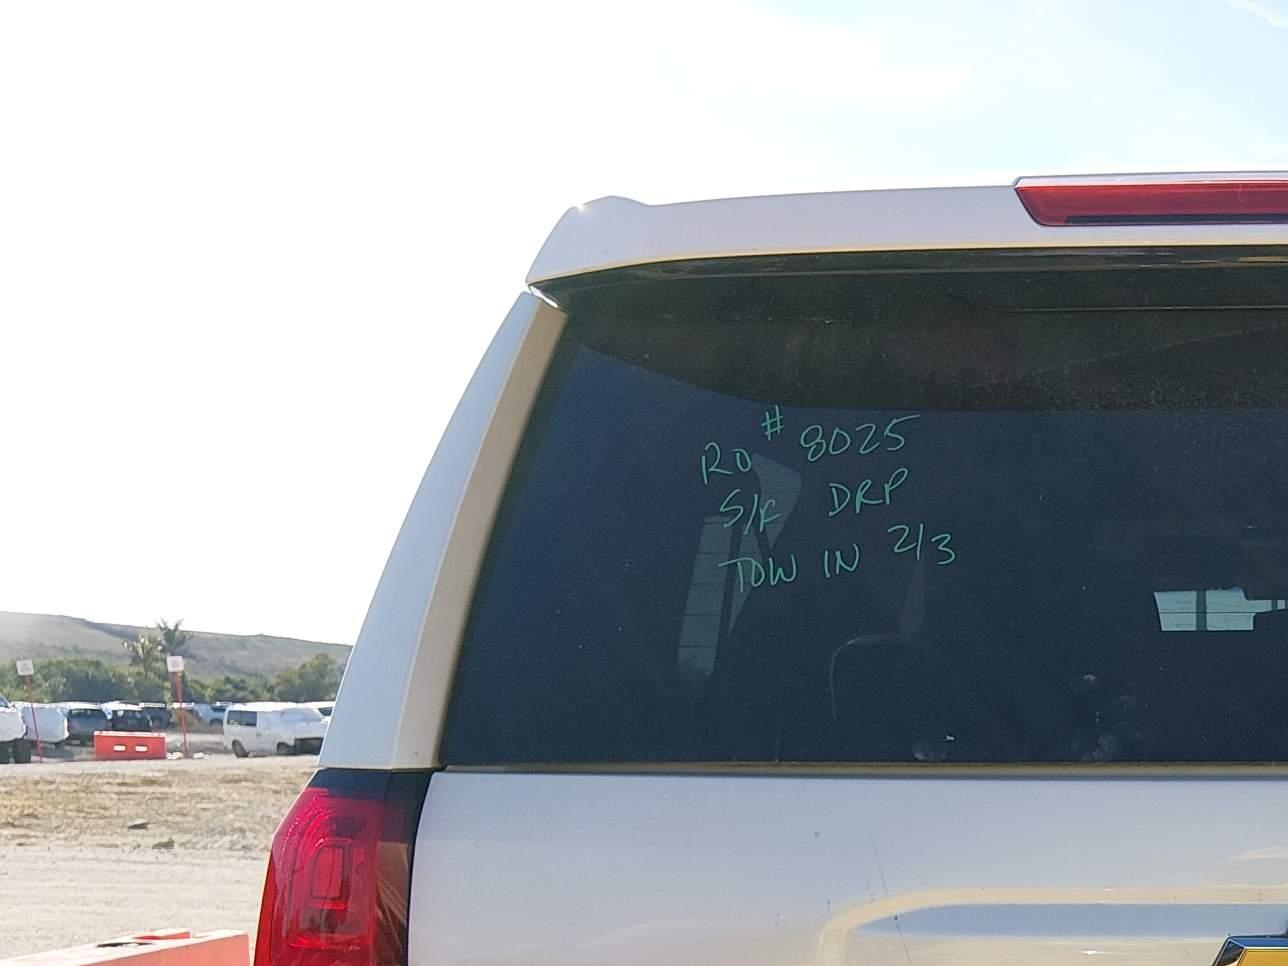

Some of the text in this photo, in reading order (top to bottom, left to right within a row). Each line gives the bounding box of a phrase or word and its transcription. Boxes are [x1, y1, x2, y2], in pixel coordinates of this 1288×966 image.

[800, 414, 921, 462] 8025
[828, 467, 909, 517] DRP
[718, 553, 797, 593] TOW
[823, 544, 861, 578] IN
